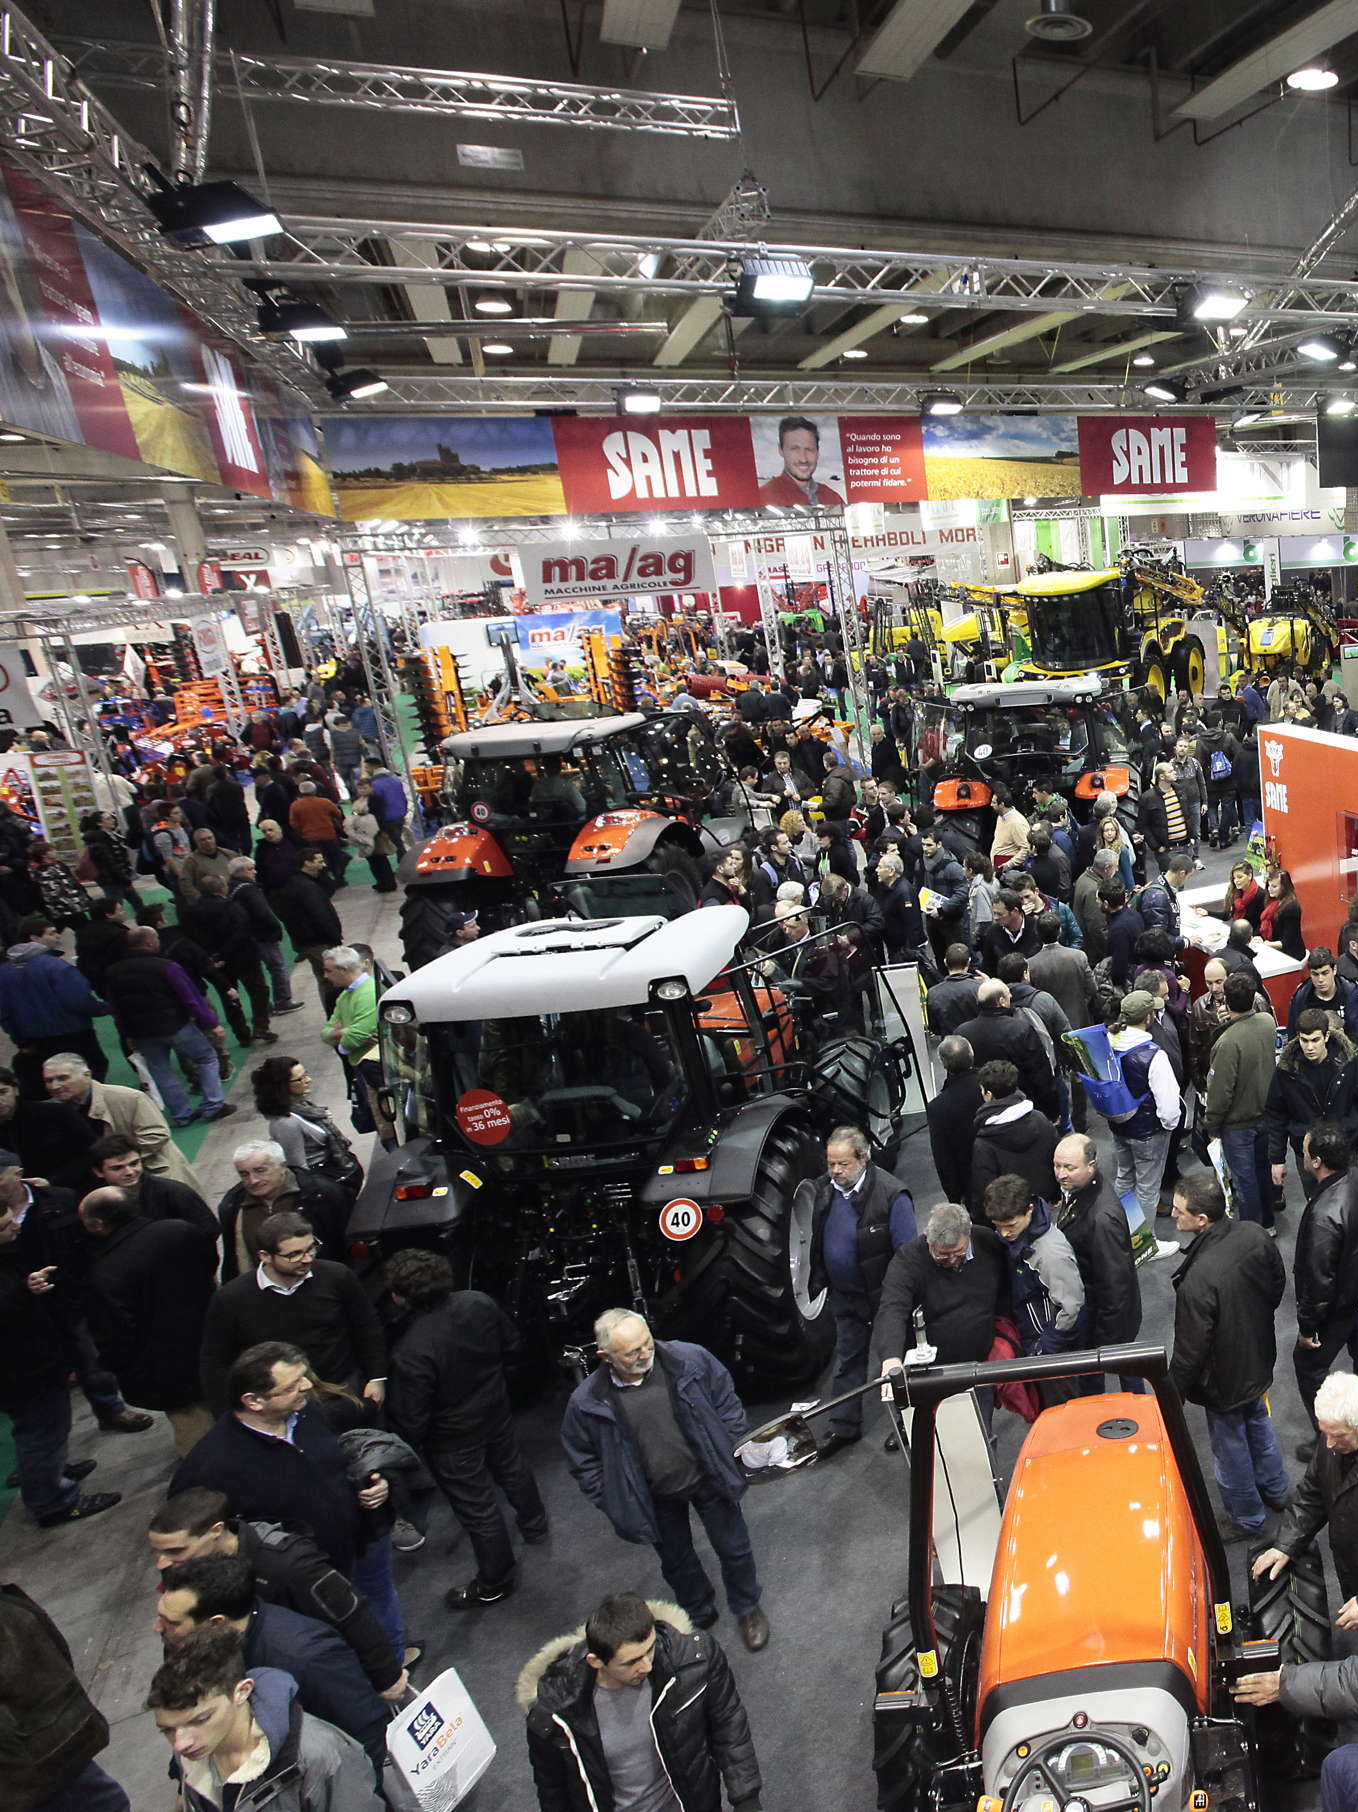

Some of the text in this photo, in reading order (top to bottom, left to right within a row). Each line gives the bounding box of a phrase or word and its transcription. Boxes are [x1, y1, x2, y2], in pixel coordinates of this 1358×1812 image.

[882, 433, 901, 441] sono
[847, 445, 854, 453] al
[855, 445, 880, 453] lavoro
[1111, 427, 1189, 485] SAME
[602, 429, 719, 500] SAME
[848, 456, 879, 466] bisogno
[880, 456, 888, 464] di
[881, 467, 889, 475] di
[890, 467, 902, 475] cui
[850, 479, 881, 489] potermi
[542, 545, 696, 586] ma/ag
[544, 581, 668, 595] MACCHINE AGRICOLE
[1265, 781, 1289, 814] SAME
[483, 1107, 501, 1119] 0%
[472, 1121, 485, 1132] 36
[486, 1114, 511, 1129] mesi
[671, 1211, 691, 1228] 40
[410, 1715, 465, 1776] YaraBela
